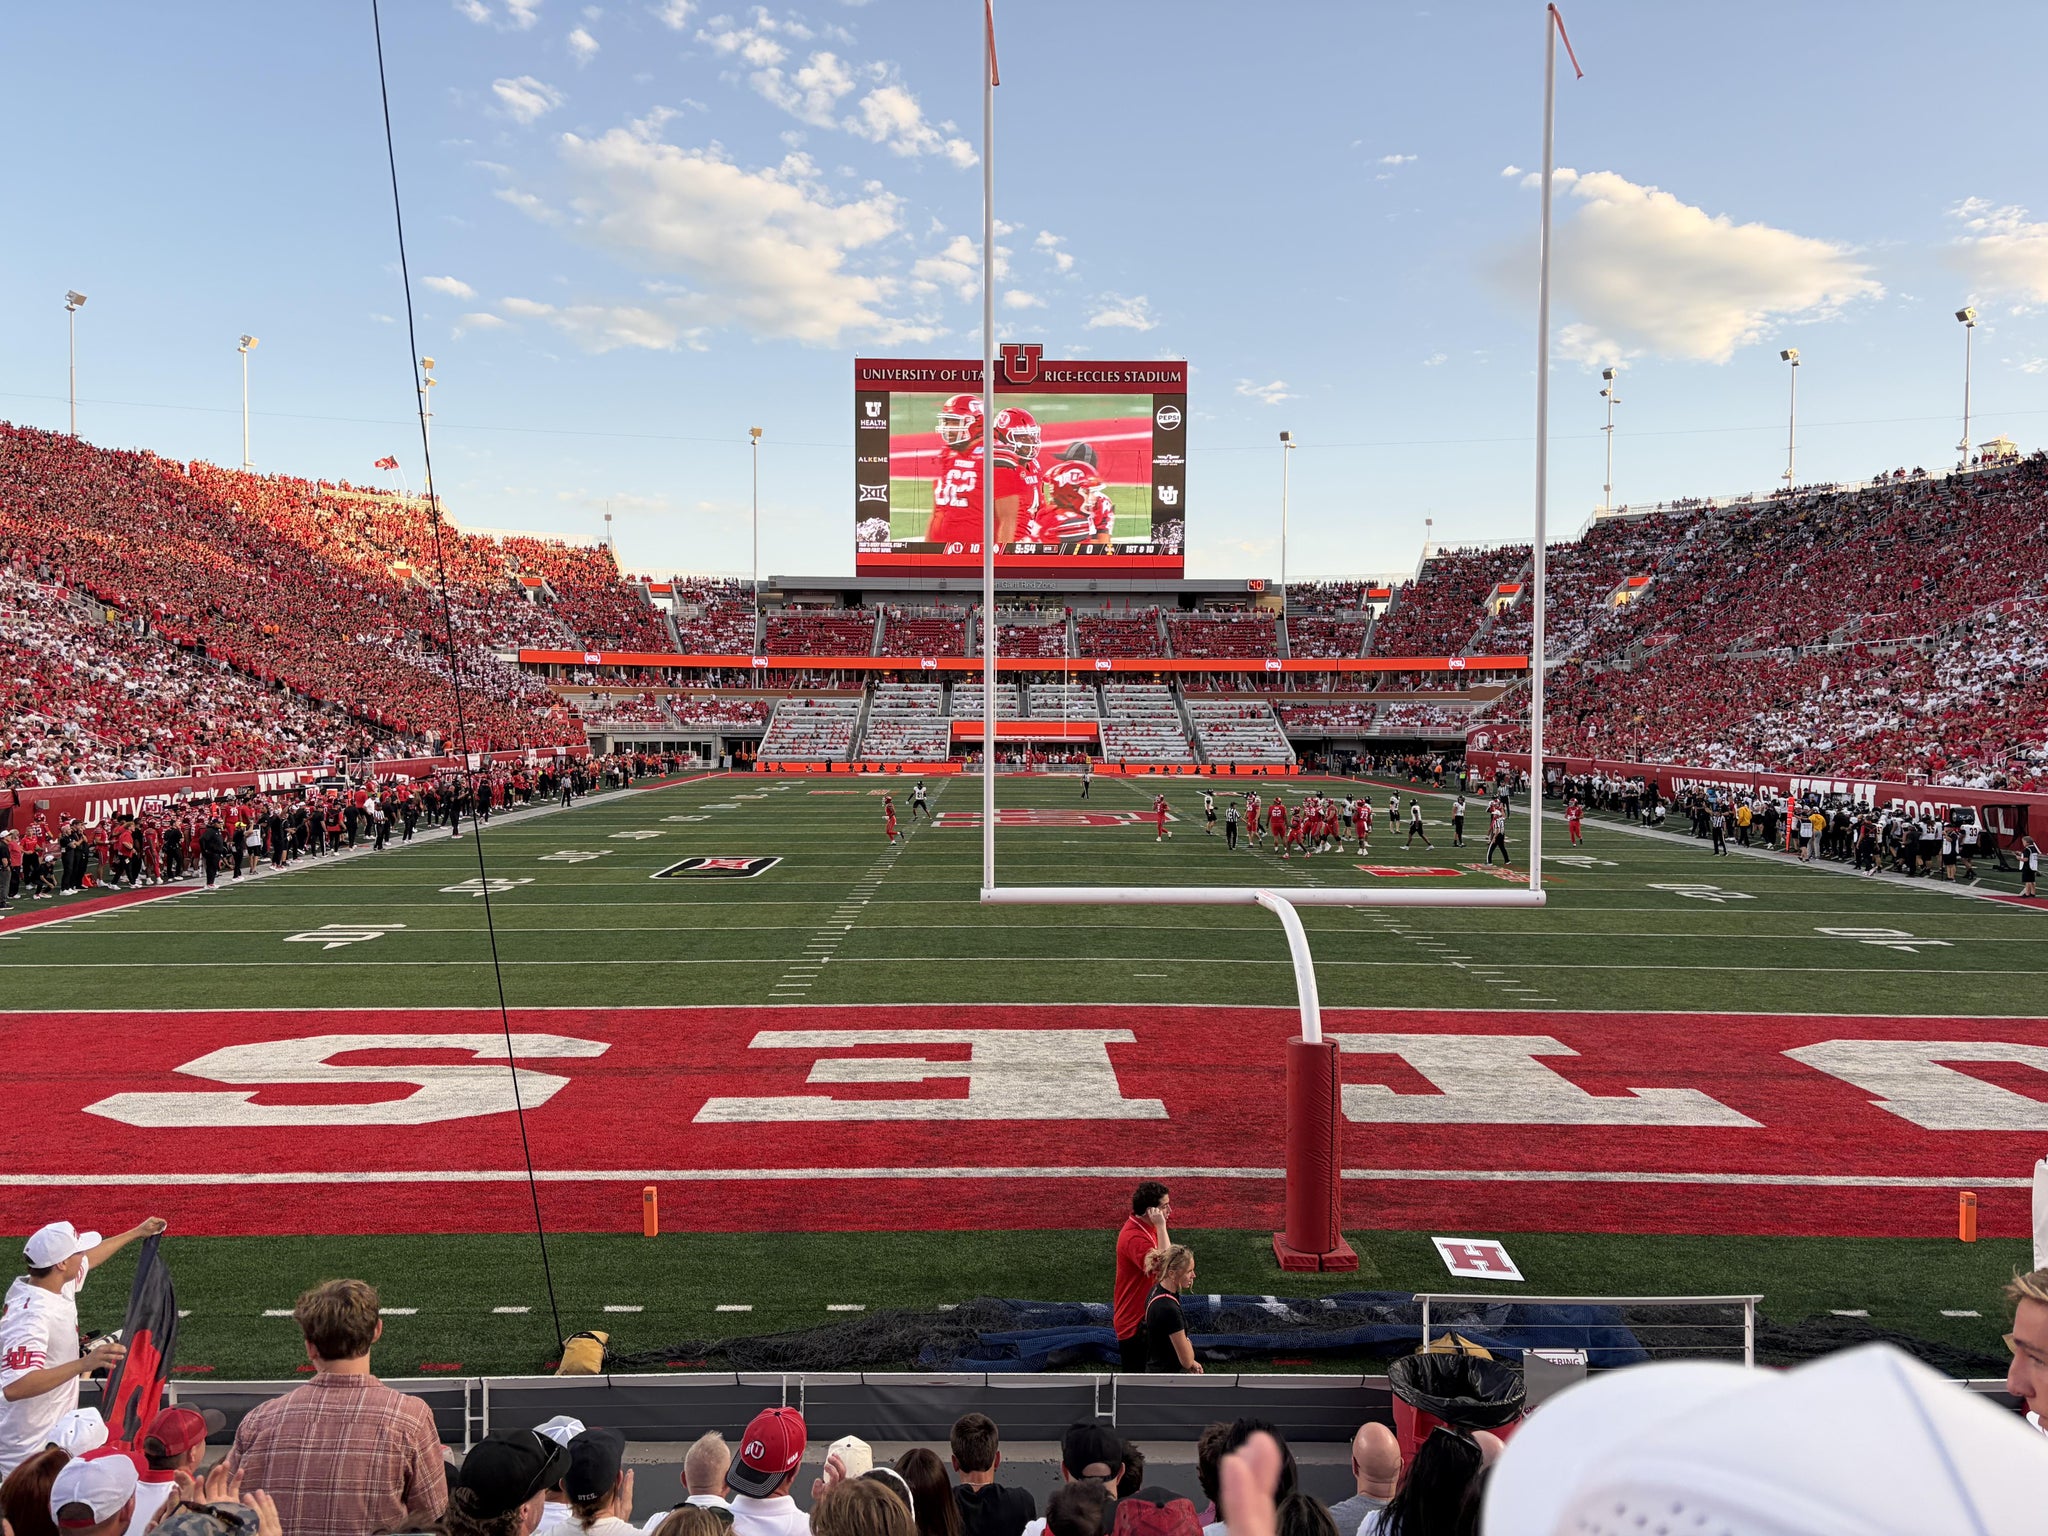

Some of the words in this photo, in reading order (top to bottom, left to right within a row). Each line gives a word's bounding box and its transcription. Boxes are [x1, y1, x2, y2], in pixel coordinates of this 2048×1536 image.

[1000, 344, 1043, 384] U
[863, 368, 936, 381] UNIVERSITY
[940, 369, 957, 381] OF
[962, 369, 995, 382] UTA
[1044, 370, 1120, 382] RICE-ECCLES
[1124, 371, 1181, 383] STADIUM
[969, 544, 980, 553] 10
[1014, 545, 1036, 554] 5:54
[1086, 545, 1093, 554] 0
[1125, 545, 1138, 554] 1ST
[1146, 545, 1155, 554] 10
[1021, 580, 1036, 589] Red
[1036, 580, 1056, 589] Zone
[1249, 580, 1263, 590] 40
[2013, 602, 2022, 611] 10
[1891, 798, 2014, 836] FOOTALL
[1969, 827, 1977, 837] 33
[283, 924, 407, 942] 10
[1814, 927, 1955, 946] 10
